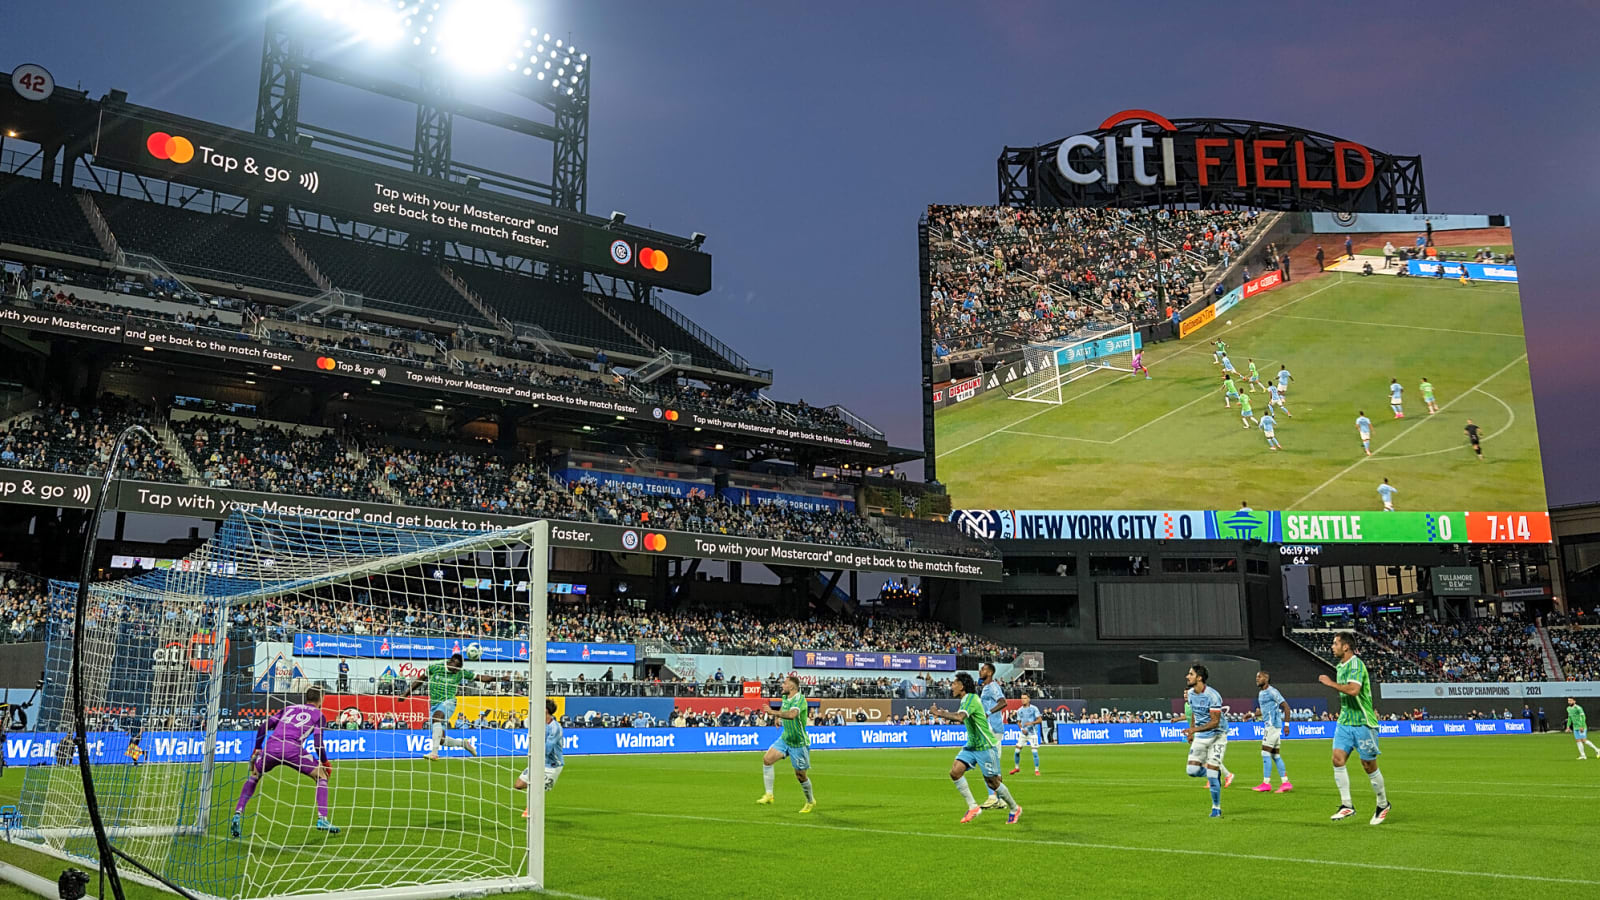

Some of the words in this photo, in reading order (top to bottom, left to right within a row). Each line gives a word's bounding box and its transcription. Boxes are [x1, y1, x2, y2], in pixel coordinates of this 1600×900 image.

[19, 72, 46, 93] 42
[1056, 123, 1177, 186] citi
[1195, 138, 1375, 189] FIELD
[200, 146, 238, 173] Tap
[243, 158, 259, 176] &
[264, 165, 290, 183] go
[375, 183, 399, 199] Tap
[402, 188, 430, 206] with
[433, 198, 460, 215] your
[537, 221, 559, 236] and
[373, 201, 395, 216] get
[399, 205, 428, 223] back
[431, 212, 445, 225] to
[448, 216, 468, 230] the
[471, 221, 509, 240] match
[511, 230, 549, 249] faster.
[22, 314, 49, 324] your
[126, 329, 146, 340] and
[149, 333, 167, 345] get
[169, 334, 194, 347] back
[196, 339, 207, 349] to
[210, 340, 226, 351] the
[228, 344, 260, 358] match
[262, 348, 294, 362] faster.
[337, 361, 353, 373] Tap
[355, 364, 362, 373] &
[364, 366, 374, 376] go
[406, 370, 422, 382] Tap
[424, 374, 443, 385] with
[445, 378, 463, 388] your
[515, 388, 530, 398] and
[532, 391, 545, 400] get
[546, 392, 564, 403] back
[566, 396, 574, 404] to
[576, 397, 588, 406] the
[590, 400, 612, 410] match
[614, 402, 638, 414] faster.
[950, 378, 981, 397] DISCOUNT
[693, 414, 706, 424] Tap
[707, 417, 722, 426] with
[722, 420, 737, 429] your
[777, 428, 788, 436] and
[790, 430, 800, 439] get
[801, 431, 814, 440] back
[823, 434, 833, 442] the
[0, 482, 16, 496] p
[22, 480, 36, 495] &
[40, 485, 64, 500] go
[604, 480, 643, 491] MILAGRO
[646, 484, 682, 495] TEQUILA
[138, 489, 172, 508] Tap
[176, 493, 215, 510] with
[220, 500, 258, 514] your
[364, 512, 392, 525] and
[396, 514, 420, 529] get
[424, 514, 458, 530] back
[461, 518, 476, 532] to
[480, 520, 502, 533] the
[790, 500, 813, 511] PORCH
[552, 526, 594, 542] faster.
[1020, 515, 1068, 539] NEW
[1068, 515, 1113, 539] YORK
[1118, 515, 1157, 539] CITY
[1180, 514, 1192, 539] 0
[1287, 515, 1362, 540] SEATTLE
[1438, 514, 1452, 540] 0
[1487, 516, 1530, 540] 7:14
[694, 539, 716, 554] Tap
[718, 542, 742, 555] with
[745, 546, 768, 558] your
[834, 552, 853, 564] and
[855, 556, 872, 566] get
[873, 556, 895, 568] back
[896, 558, 907, 569] to
[908, 558, 924, 570] the
[926, 562, 953, 572] match
[954, 562, 983, 575] faster.
[1280, 546, 1308, 556] 06:19
[1309, 546, 1319, 556] PM
[400, 663, 426, 678] Coo
[1448, 686, 1462, 695] MLS
[1462, 686, 1474, 695] CUP
[1475, 686, 1510, 695] CHAMPIONS
[1526, 686, 1541, 695] 2021
[281, 708, 312, 728] 49
[1072, 728, 1109, 740] Walmart
[1160, 727, 1184, 738] Walm
[1297, 725, 1325, 735] Walmart
[1410, 723, 1433, 733] Walmart
[1444, 723, 1466, 732] Walmart
[1475, 723, 1496, 732] Walmart
[1504, 722, 1525, 731] Walmart
[616, 733, 675, 748] Walmart
[705, 732, 759, 746] Walmart
[808, 731, 836, 744] mart
[861, 730, 908, 743] Walmart
[930, 729, 968, 742] Walmar
[7, 740, 104, 758] Walrt
[303, 736, 365, 753] almart
[1360, 740, 1374, 750] 25
